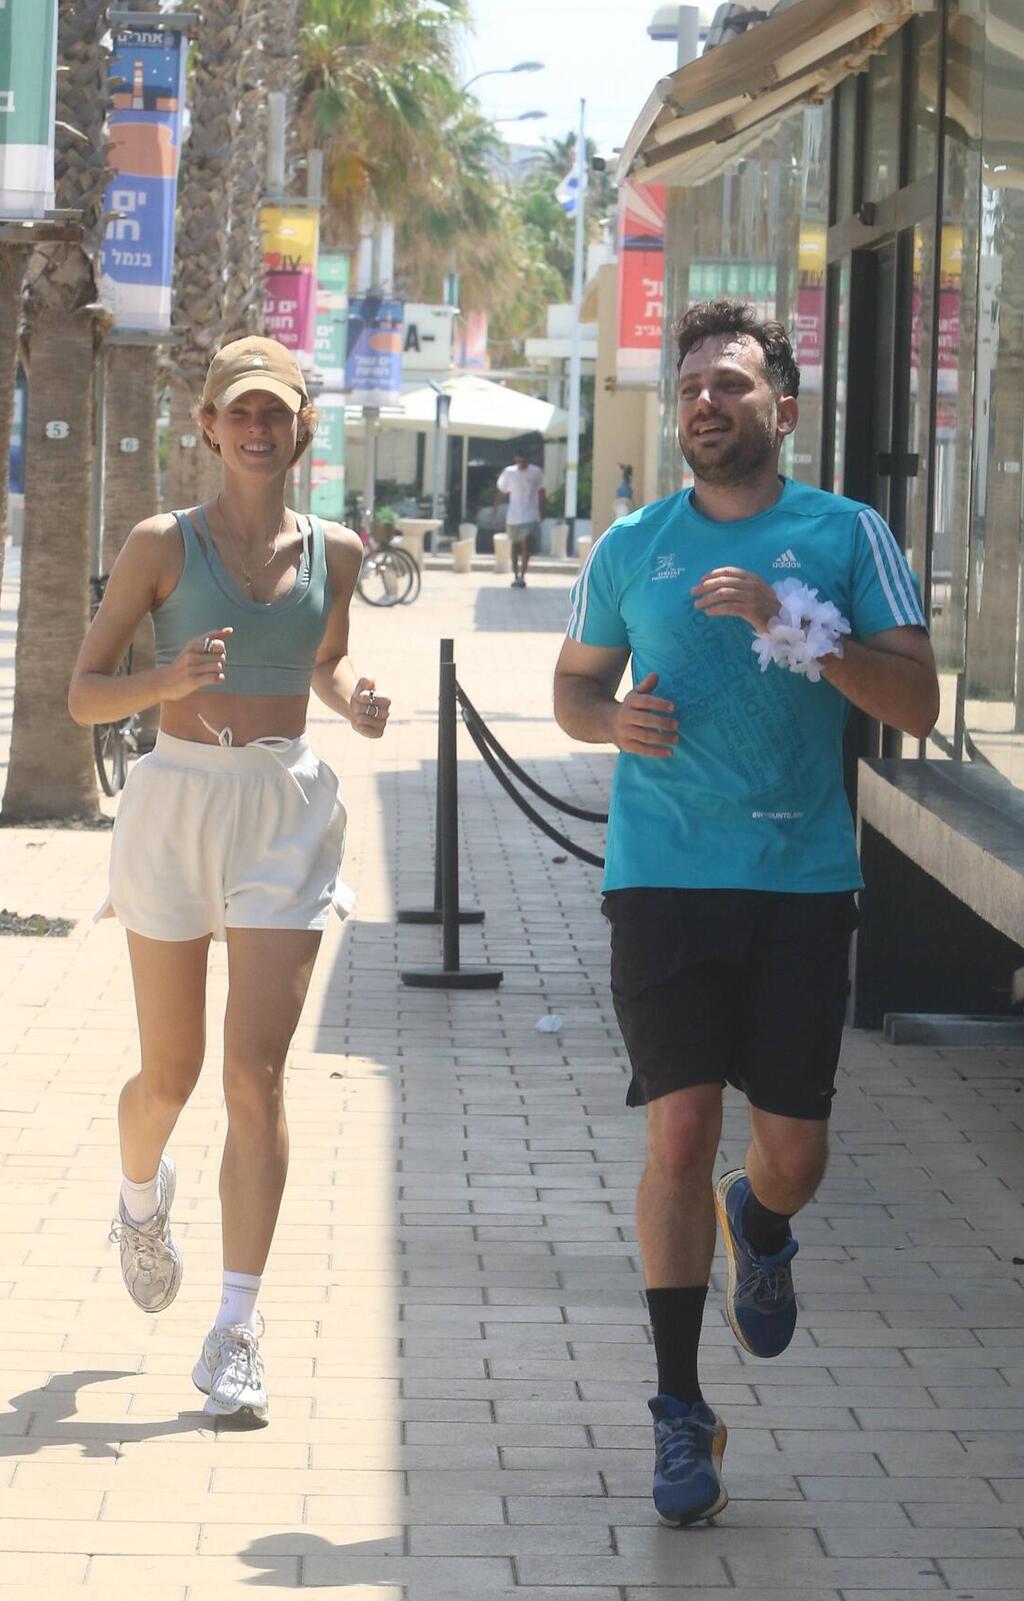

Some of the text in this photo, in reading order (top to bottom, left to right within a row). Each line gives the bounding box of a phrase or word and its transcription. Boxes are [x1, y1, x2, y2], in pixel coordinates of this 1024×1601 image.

[112, 190, 146, 212] ים
[111, 248, 152, 268] בנמל
[53, 423, 61, 437] 5
[772, 561, 801, 569] adidas
